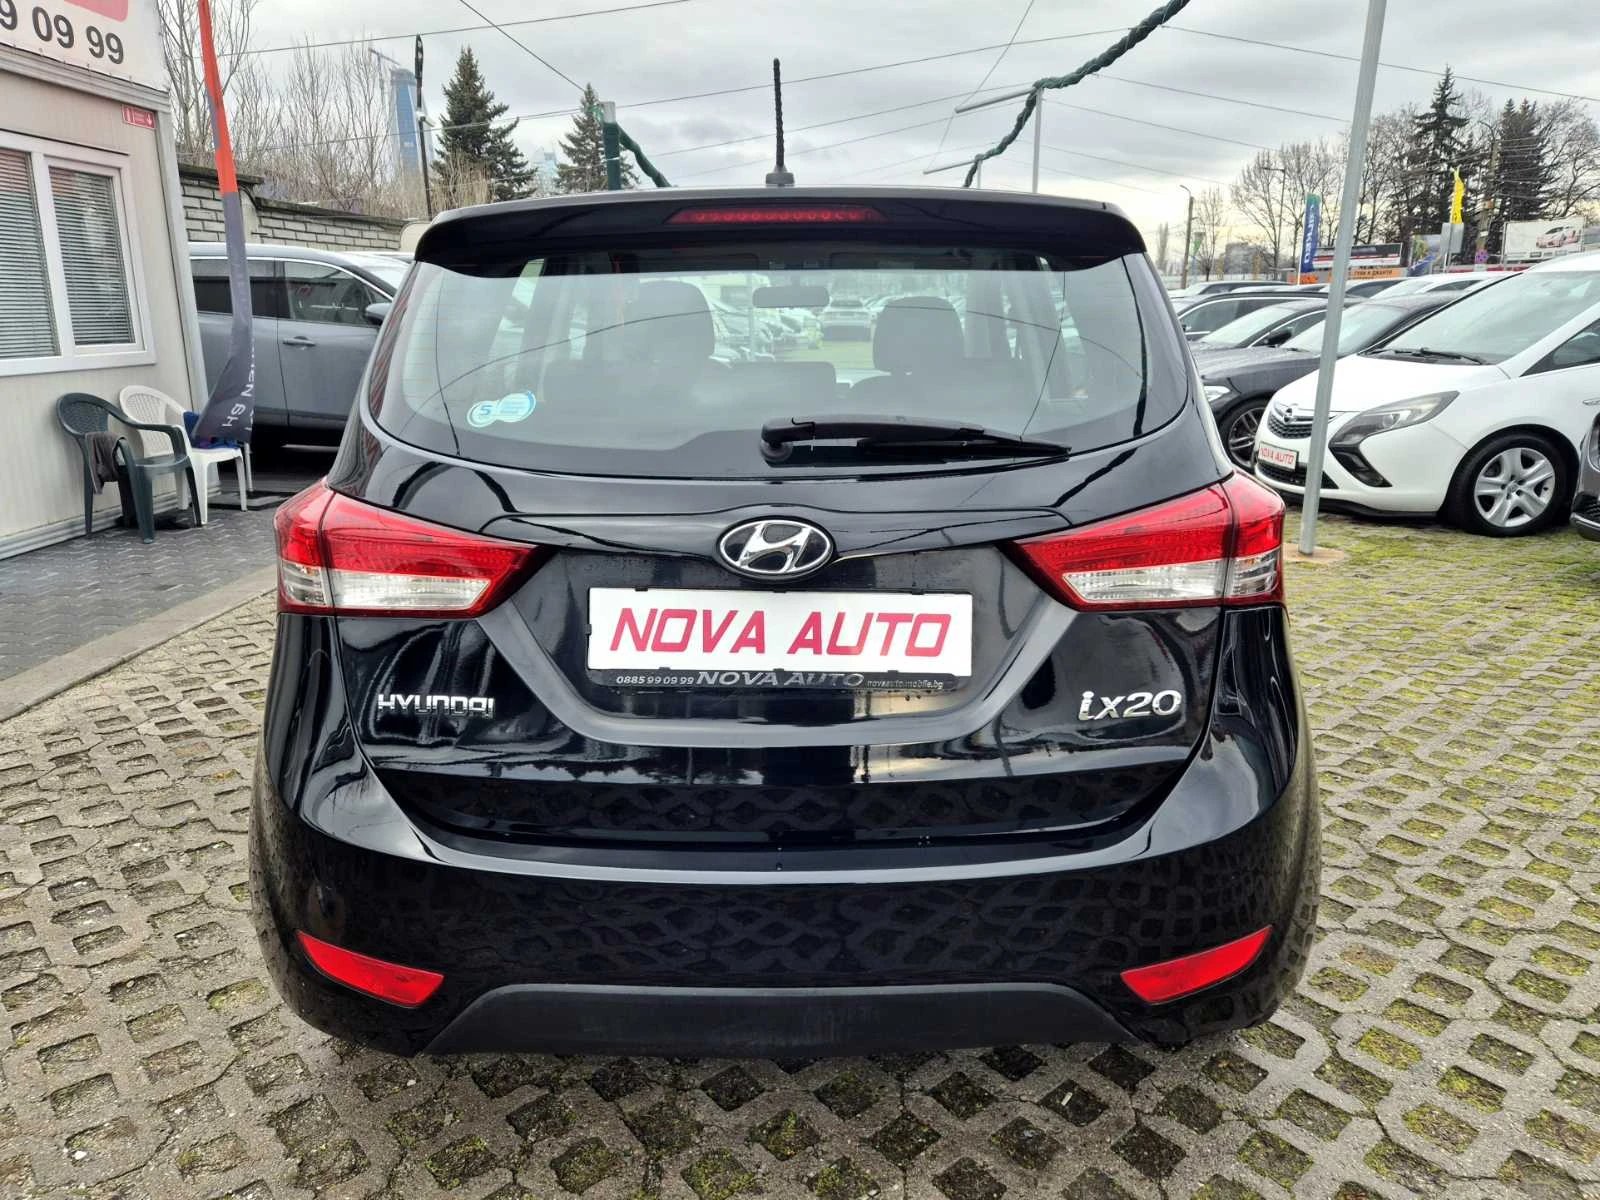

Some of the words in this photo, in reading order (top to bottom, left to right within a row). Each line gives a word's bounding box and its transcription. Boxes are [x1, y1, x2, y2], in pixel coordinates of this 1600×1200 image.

[32, 6, 75, 49] 09
[86, 25, 124, 65] 99
[1275, 452, 1295, 465] AUTO
[610, 607, 766, 654] NOVA
[786, 611, 952, 658] AUTO
[616, 675, 646, 685] 0885
[647, 676, 662, 685] 99
[663, 676, 678, 685] 09
[679, 676, 695, 686] 99
[696, 671, 779, 686] NOVA
[783, 672, 865, 687] AUTO
[378, 693, 495, 717] HYUNDAI
[1078, 689, 1182, 721] ix20
